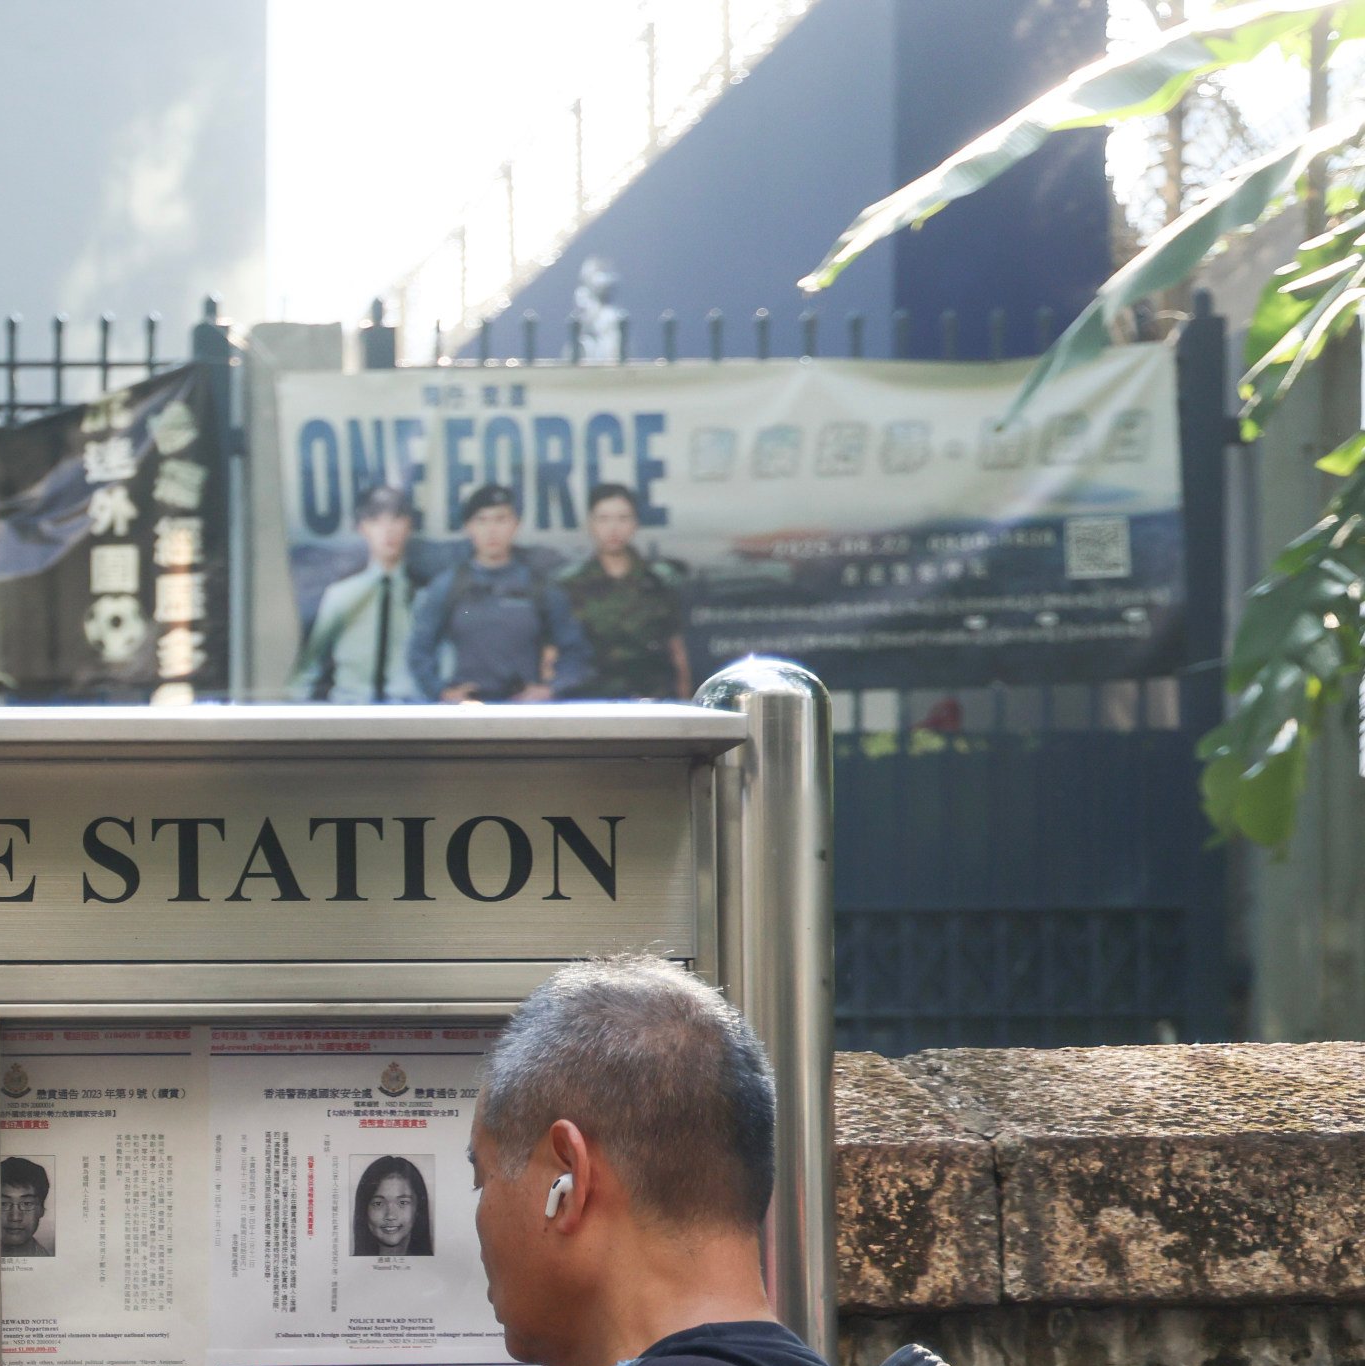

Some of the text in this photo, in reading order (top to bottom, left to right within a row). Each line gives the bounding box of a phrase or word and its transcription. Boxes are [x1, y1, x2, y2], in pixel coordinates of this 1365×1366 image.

[300, 419, 425, 535] ONE
[444, 412, 669, 531] FORCE
[83, 815, 626, 904] STATION
[82, 1090, 102, 1098] 2023
[105, 1089, 126, 1099] 年第
[129, 1089, 134, 1098] 9
